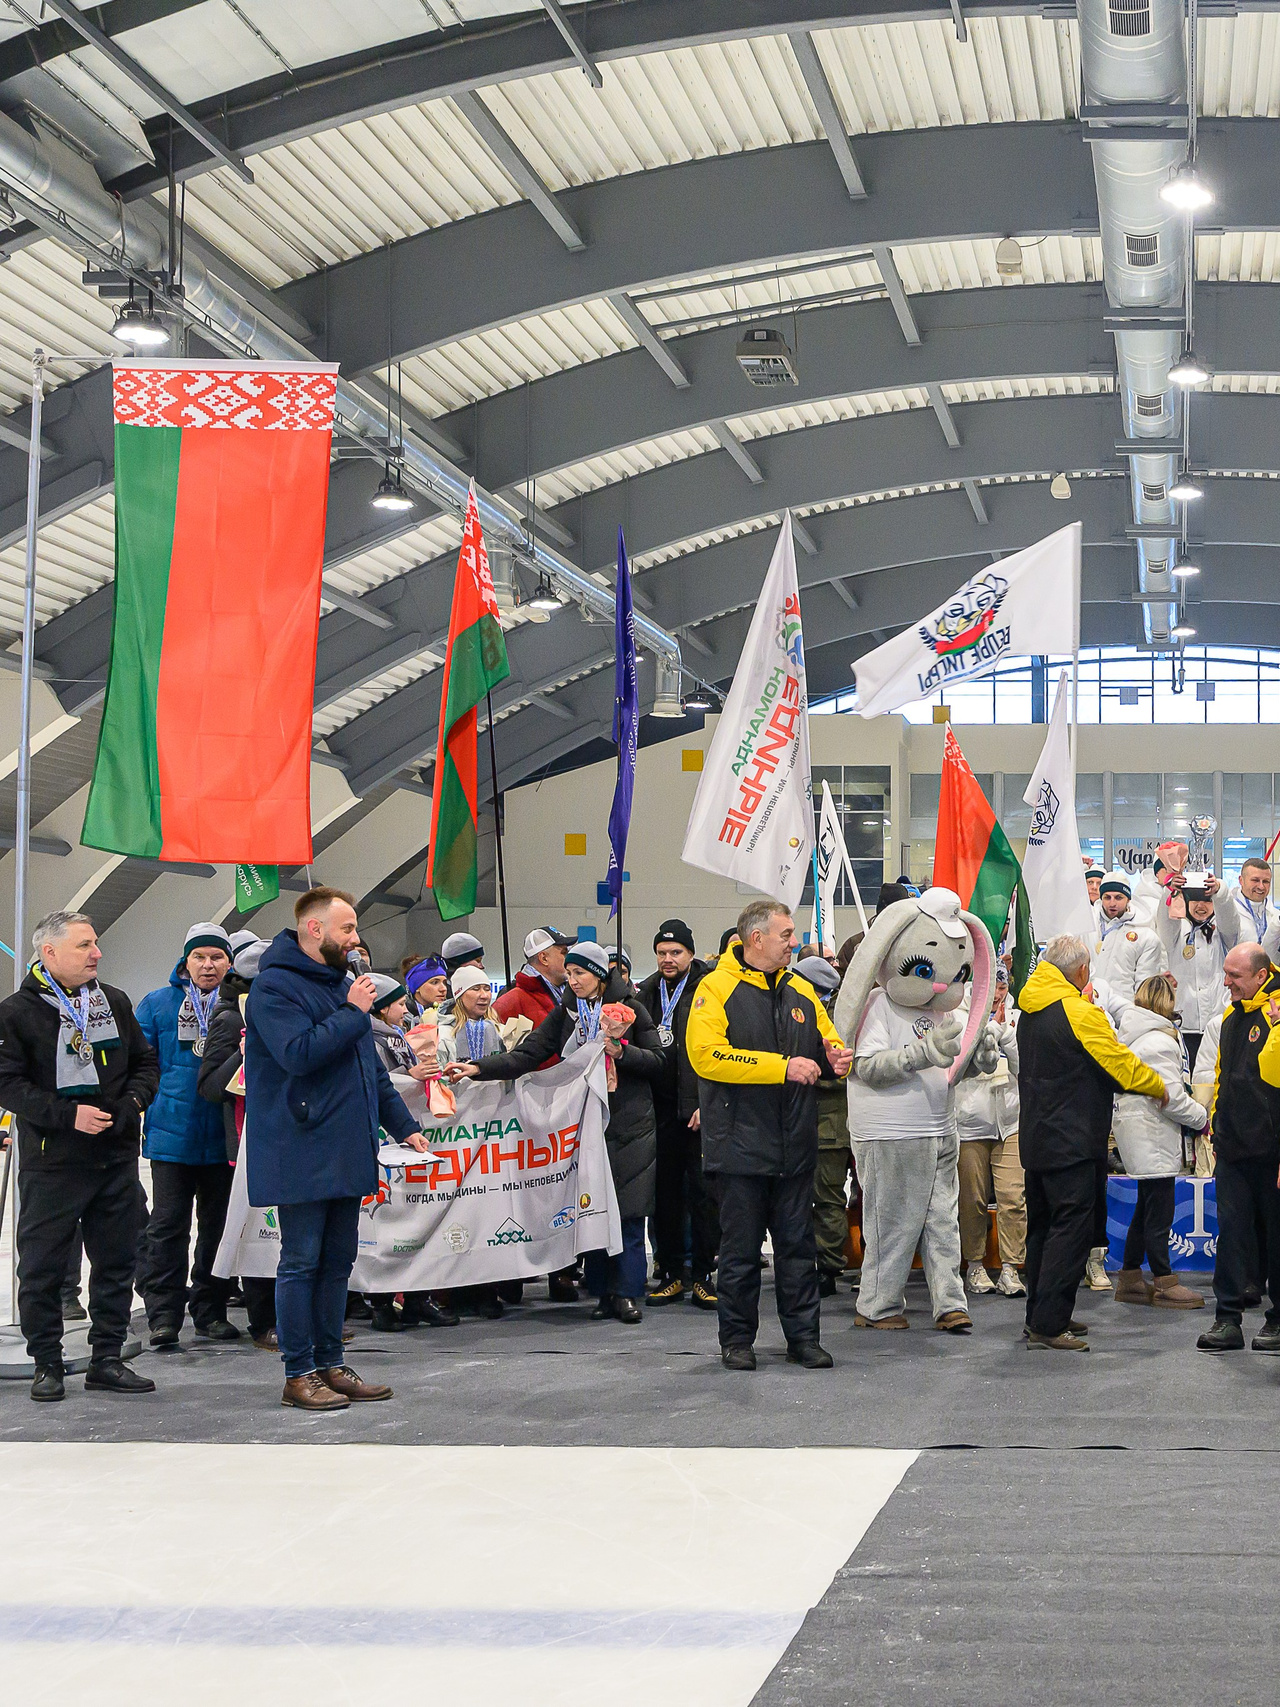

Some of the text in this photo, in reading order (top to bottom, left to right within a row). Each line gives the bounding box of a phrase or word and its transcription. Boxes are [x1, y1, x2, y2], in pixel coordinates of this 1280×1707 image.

[421, 1118, 523, 1144] ОМАНДА
[405, 1123, 581, 1191] ЕДИНЫЕ
[405, 1193, 434, 1205] КОГДА
[502, 1182, 522, 1192] МЫ
